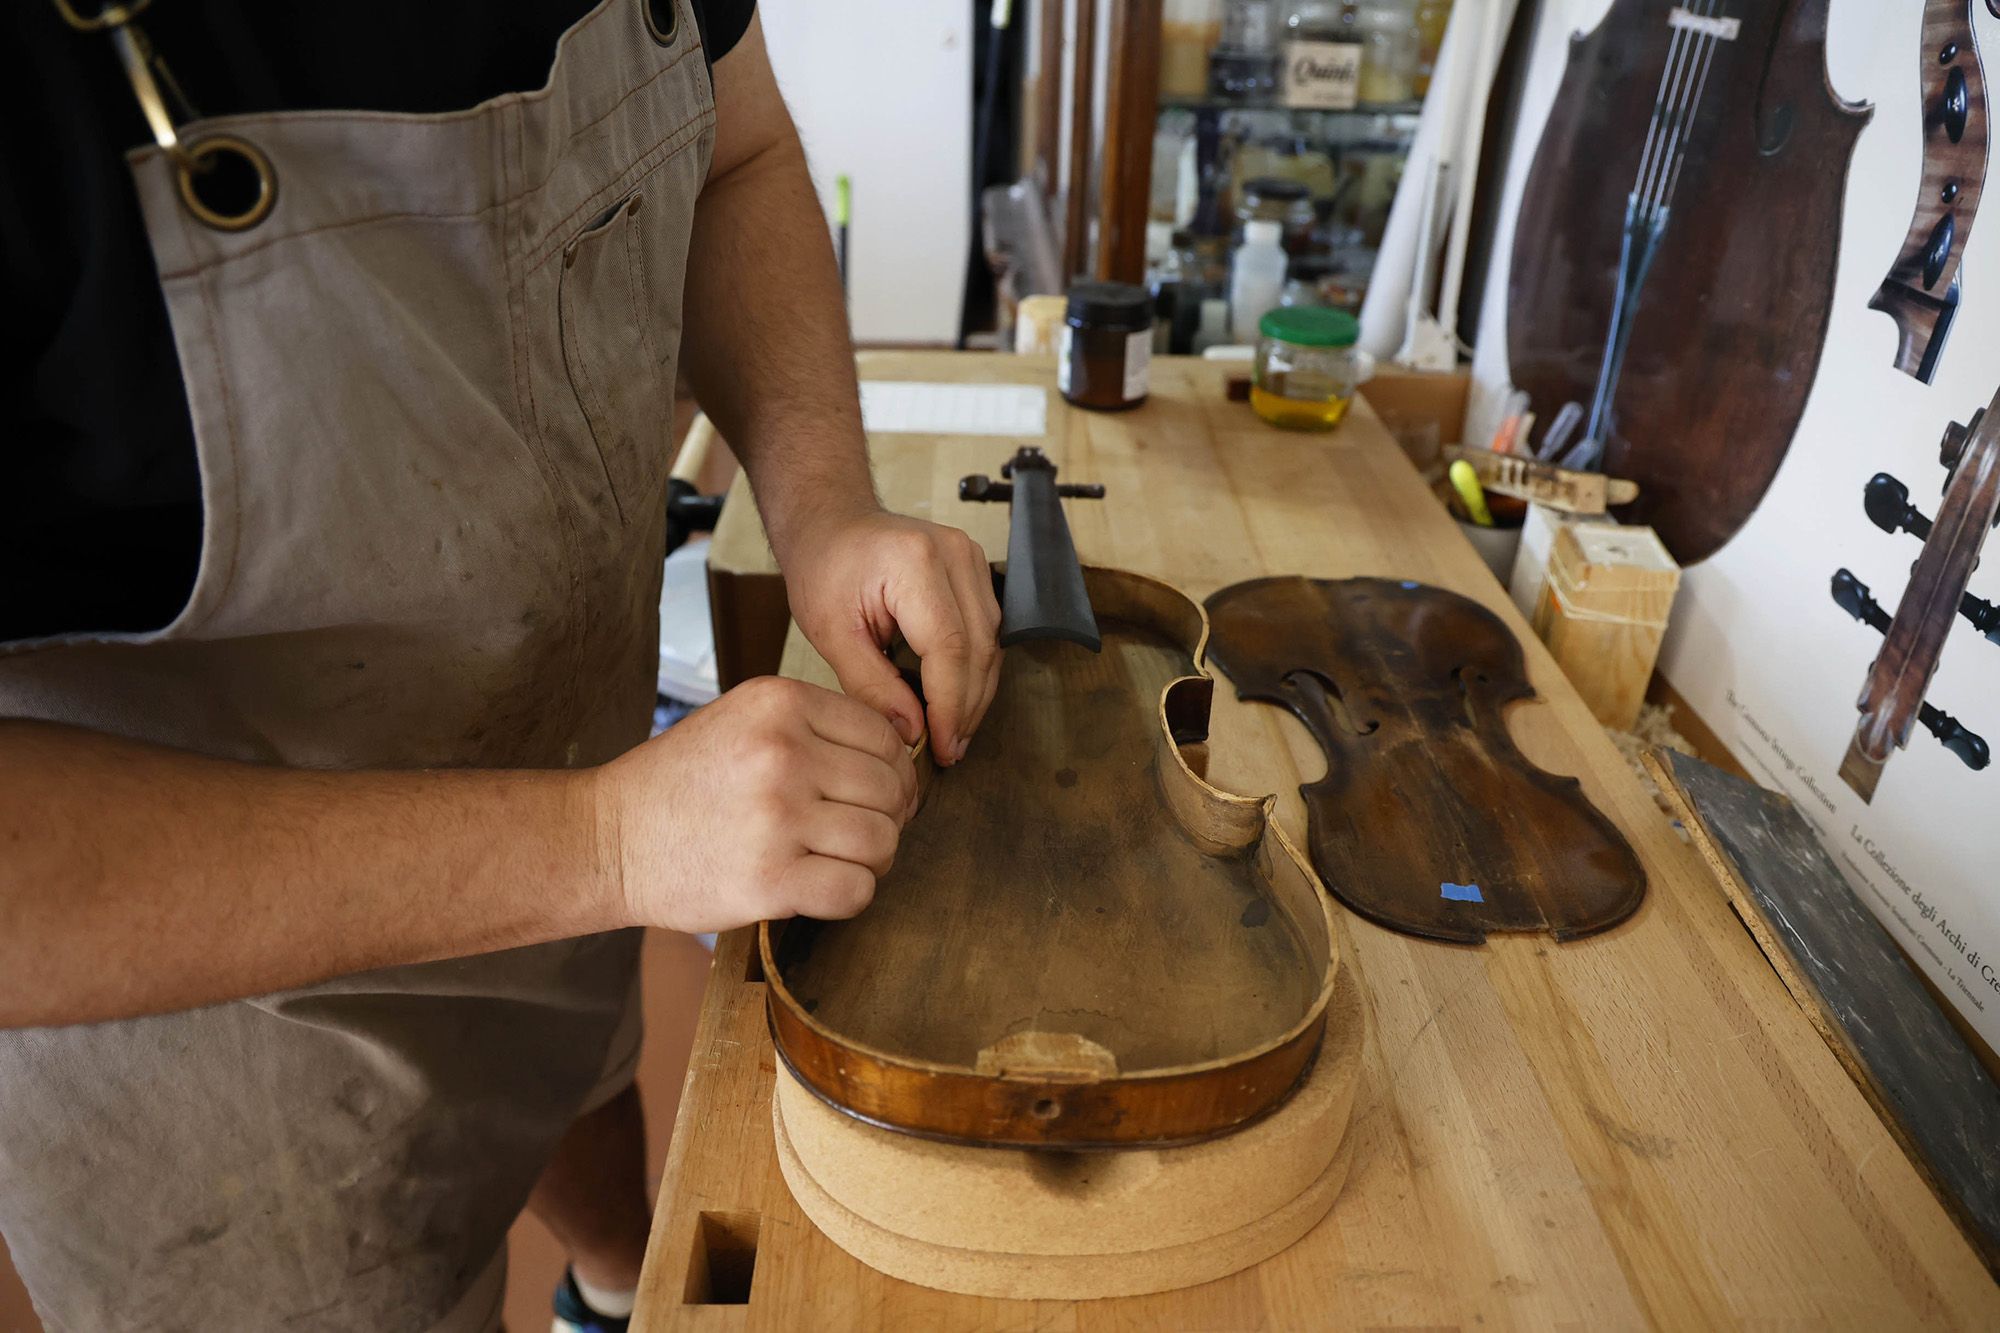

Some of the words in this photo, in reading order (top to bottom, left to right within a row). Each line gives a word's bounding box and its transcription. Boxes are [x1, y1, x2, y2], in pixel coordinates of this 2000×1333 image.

[1795, 765, 1838, 814] Collection
[1850, 824, 1863, 844] La
[1863, 838, 1911, 895] Collezione
[1911, 892, 1938, 922] degli
[1936, 919, 1967, 954] Archi
[1967, 952, 1981, 968] di
[1946, 967, 1957, 981] La
[1956, 976, 1984, 1012] Triennale
